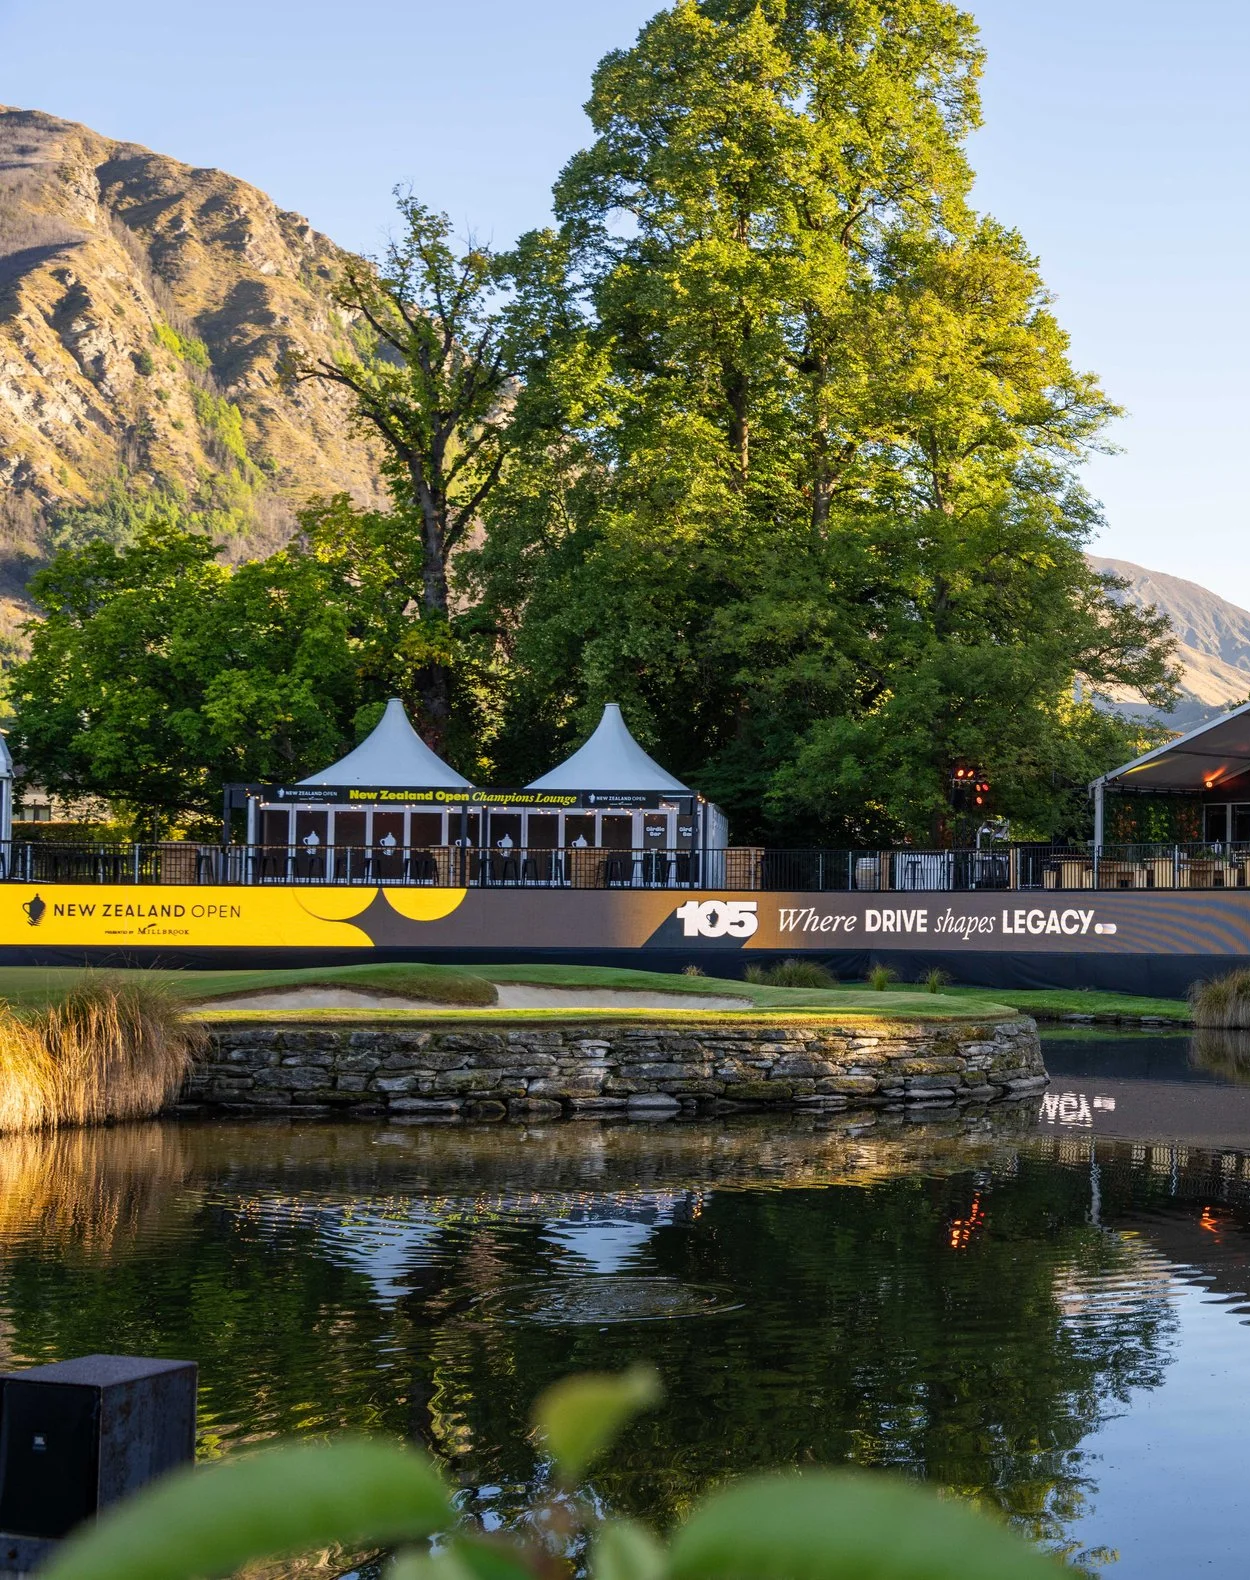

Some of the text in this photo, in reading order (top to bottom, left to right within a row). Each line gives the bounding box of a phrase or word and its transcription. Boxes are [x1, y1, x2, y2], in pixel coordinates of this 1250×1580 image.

[350, 790, 576, 806] New Zealand Open Champions Lounge
[54, 904, 241, 918] NEW ZEALAND OPEN
[676, 900, 758, 937] 105
[137, 927, 189, 936] MILLBROOK
[778, 908, 857, 933] Where
[865, 910, 927, 933] DRIVE
[934, 909, 995, 940] shapes
